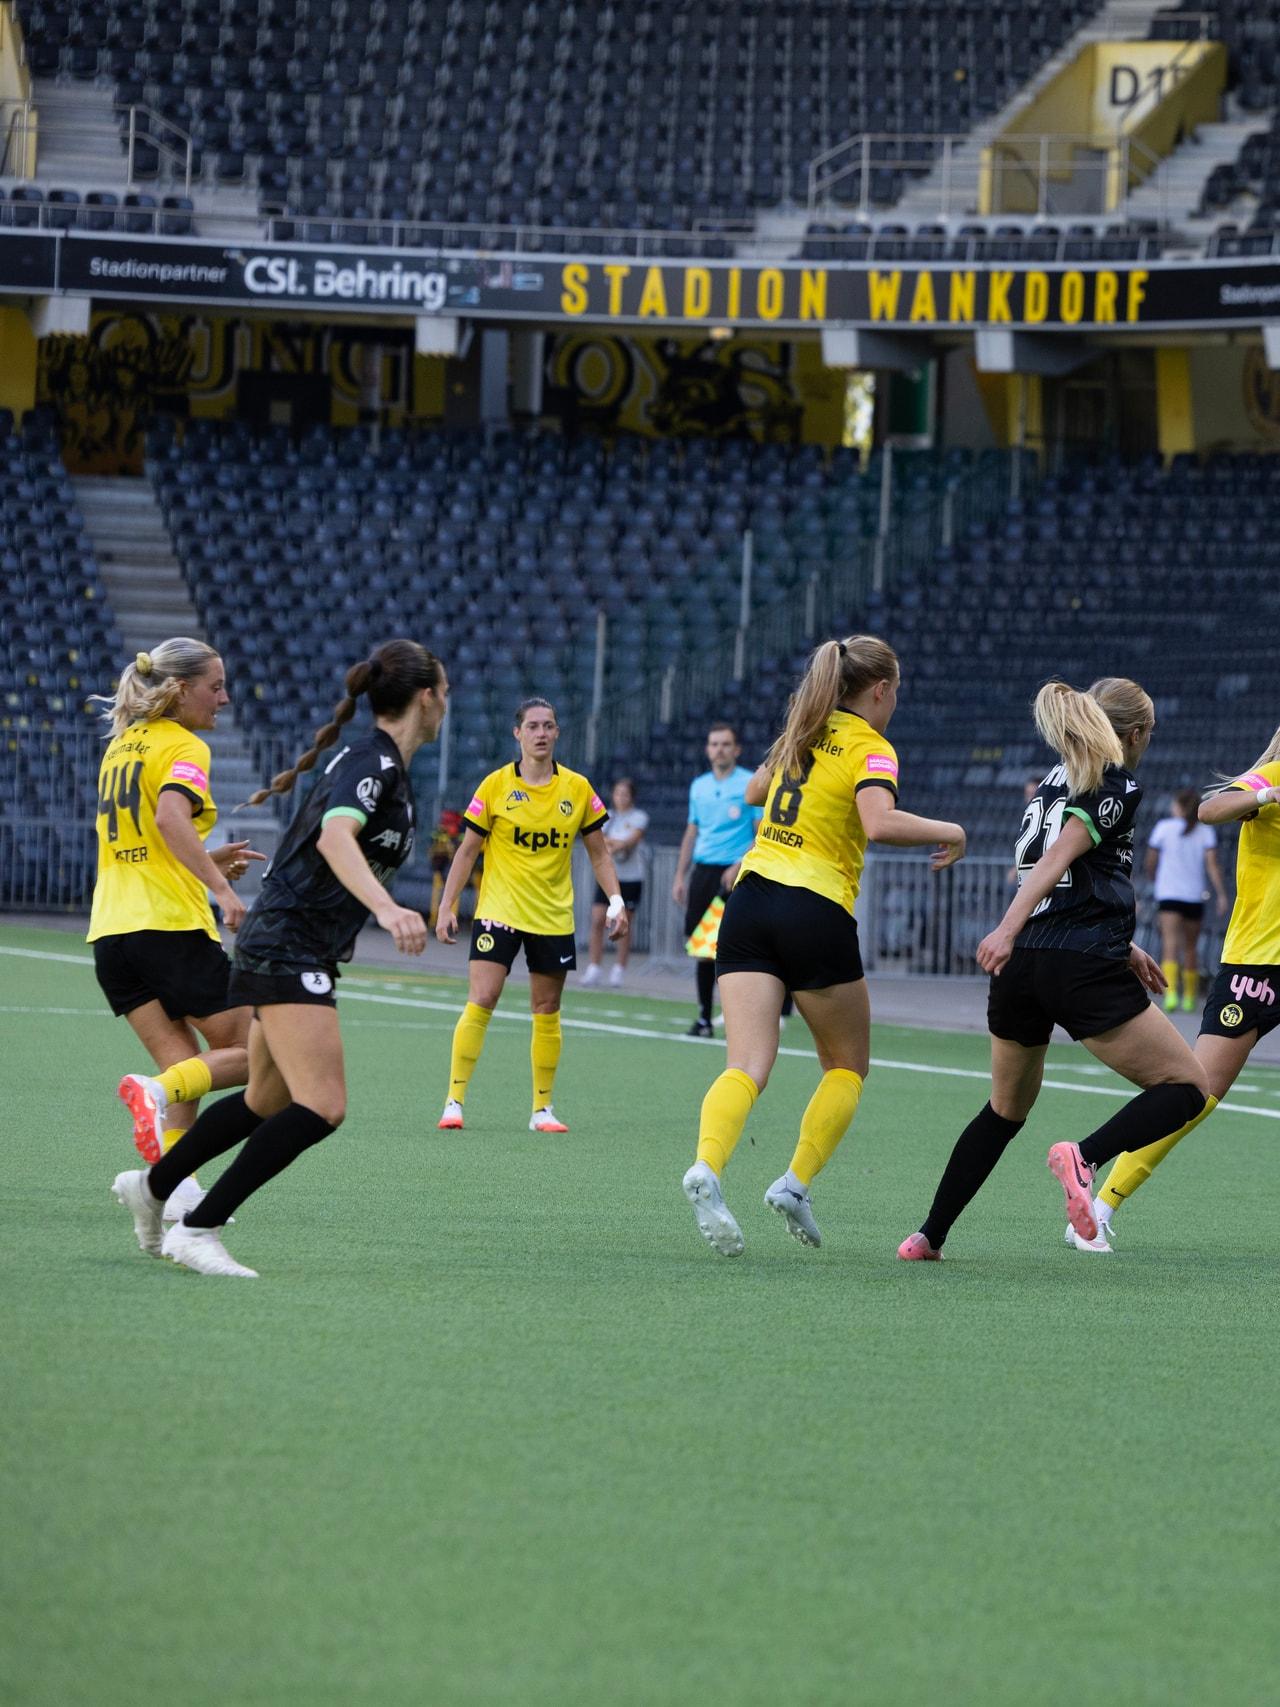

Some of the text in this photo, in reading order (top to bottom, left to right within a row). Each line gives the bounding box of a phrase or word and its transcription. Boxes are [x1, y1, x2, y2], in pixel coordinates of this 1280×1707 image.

[89, 255, 228, 284] Stadionpartner
[313, 259, 447, 312] Behring
[560, 262, 1150, 325] STADION WANKDORF
[98, 760, 145, 843] 44
[769, 750, 816, 828] 8
[514, 827, 569, 851] kpt:
[1015, 796, 1073, 889] 21
